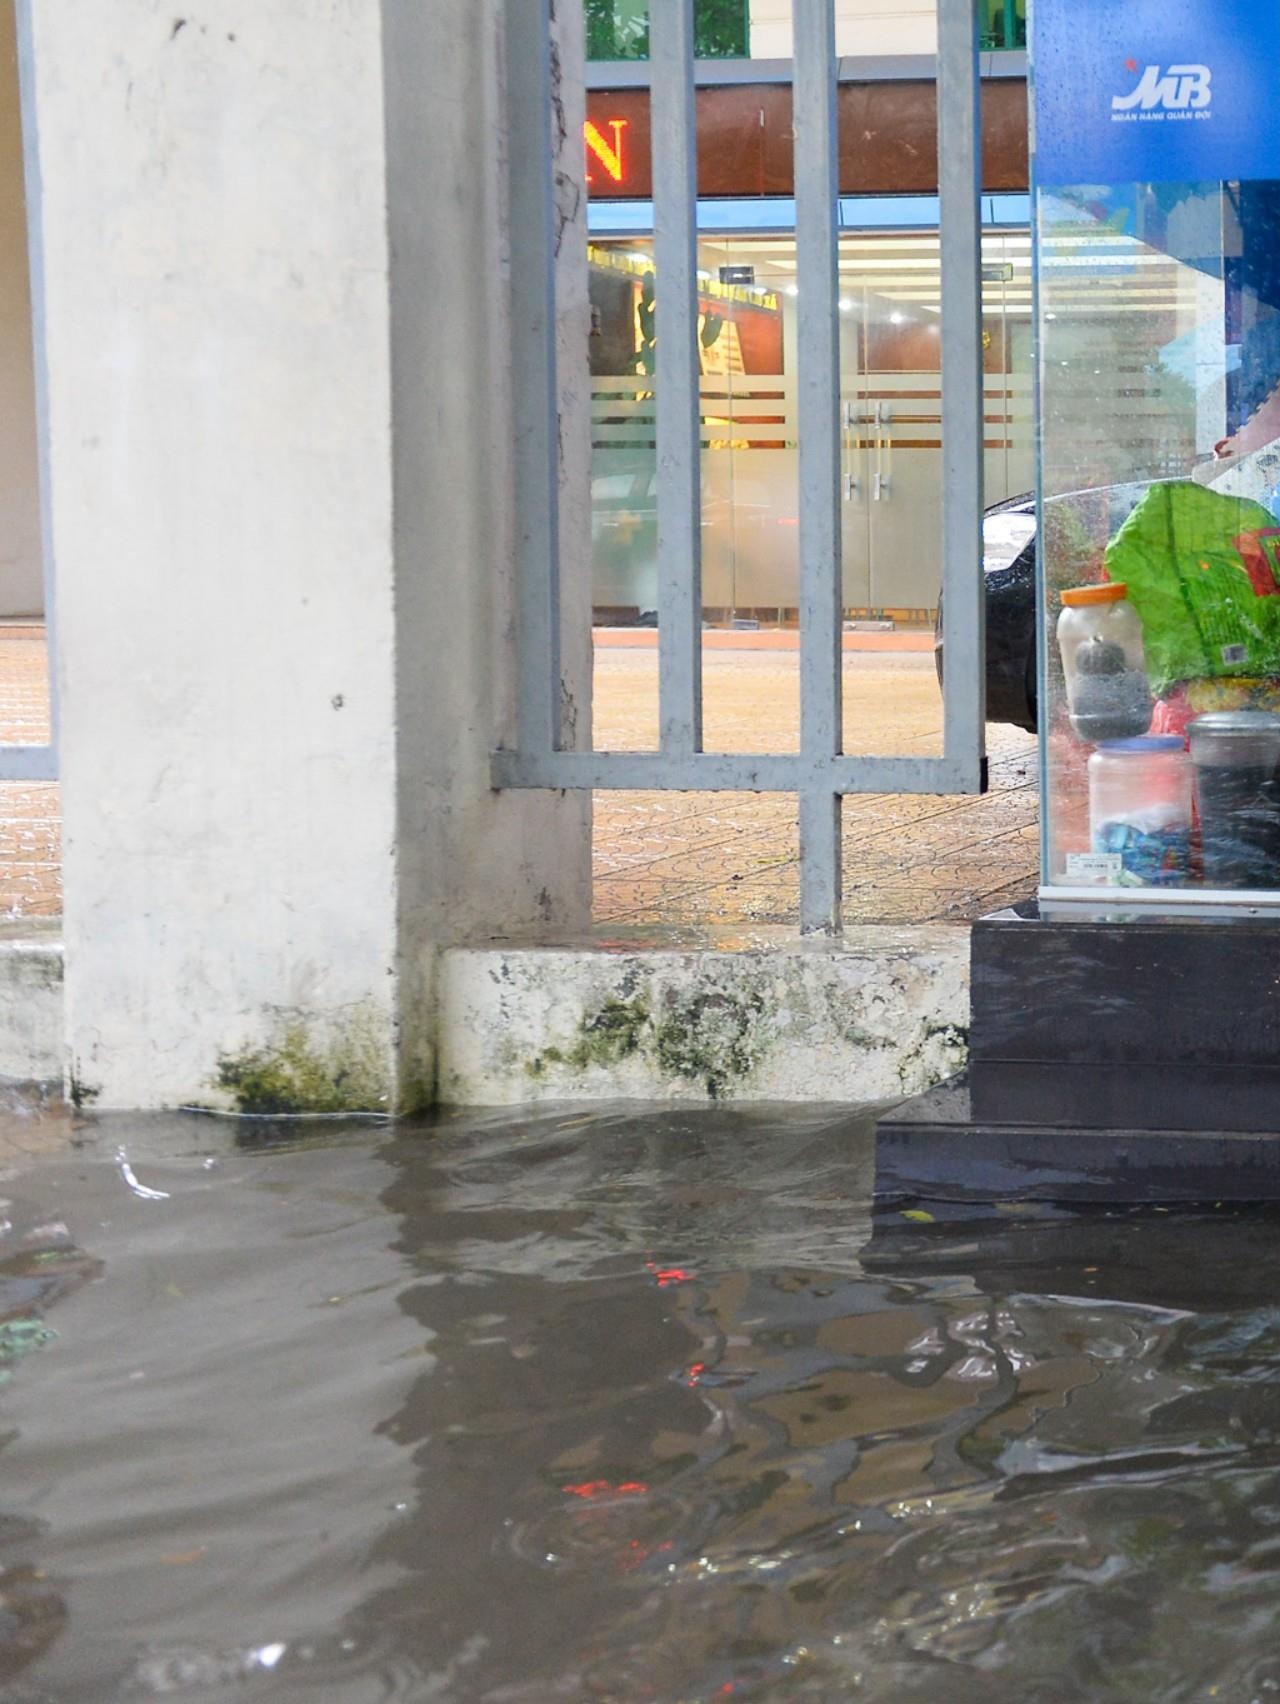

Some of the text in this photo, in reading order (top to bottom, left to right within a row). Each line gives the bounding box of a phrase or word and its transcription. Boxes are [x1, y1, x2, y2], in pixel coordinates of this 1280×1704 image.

[1111, 64, 1212, 110] MB
[1110, 112, 1137, 121] NGÂN
[1138, 111, 1164, 121] HÀNG
[1167, 110, 1192, 120] QUÂN
